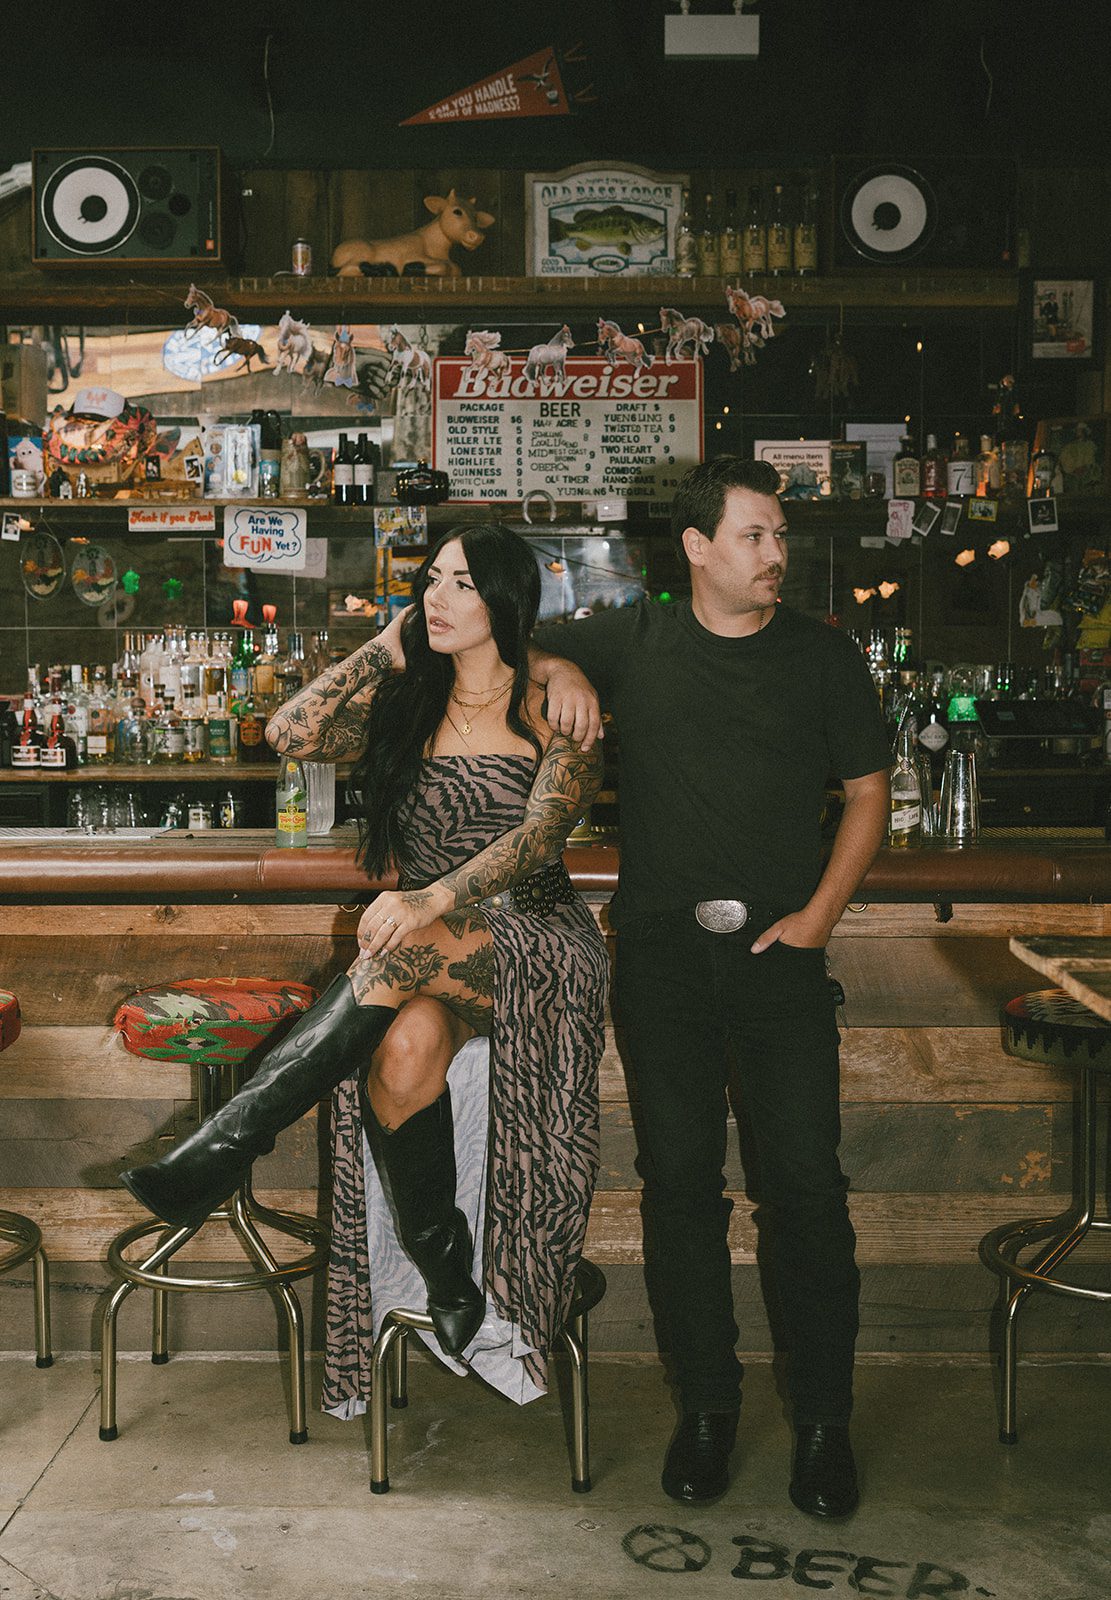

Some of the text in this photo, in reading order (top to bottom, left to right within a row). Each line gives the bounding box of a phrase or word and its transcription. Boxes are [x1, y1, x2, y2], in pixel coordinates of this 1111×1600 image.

[451, 92, 472, 108] YOU
[474, 73, 517, 102] HANDLE
[462, 106, 472, 116] OF
[475, 94, 520, 114] MADNESS?
[542, 186, 674, 208] OLD BASS LODGE
[452, 365, 680, 398] Budweiser
[540, 402, 581, 417] BEER
[447, 416, 500, 424] BUDWEISER
[669, 414, 675, 422] 6
[556, 419, 578, 428] ACRE
[448, 426, 522, 434] OLD STYLE 5
[604, 424, 675, 433] TWISTED TEA 9
[516, 437, 522, 445] 6
[601, 435, 660, 443] MODELO 9
[516, 447, 522, 455] 6
[623, 446, 652, 454] HEART
[664, 445, 670, 453] 9
[589, 451, 595, 459] 9
[610, 456, 675, 464] PAULANER 9
[530, 463, 591, 471] OBERON 9
[516, 468, 523, 476] 9
[562, 475, 589, 484] TIMER
[517, 489, 524, 497] 9
[616, 488, 655, 496] TEQUILA
[161, 512, 168, 524] if
[170, 515, 185, 525] you
[248, 515, 283, 526] Are We
[252, 526, 284, 537] Having
[240, 536, 272, 554] FUN
